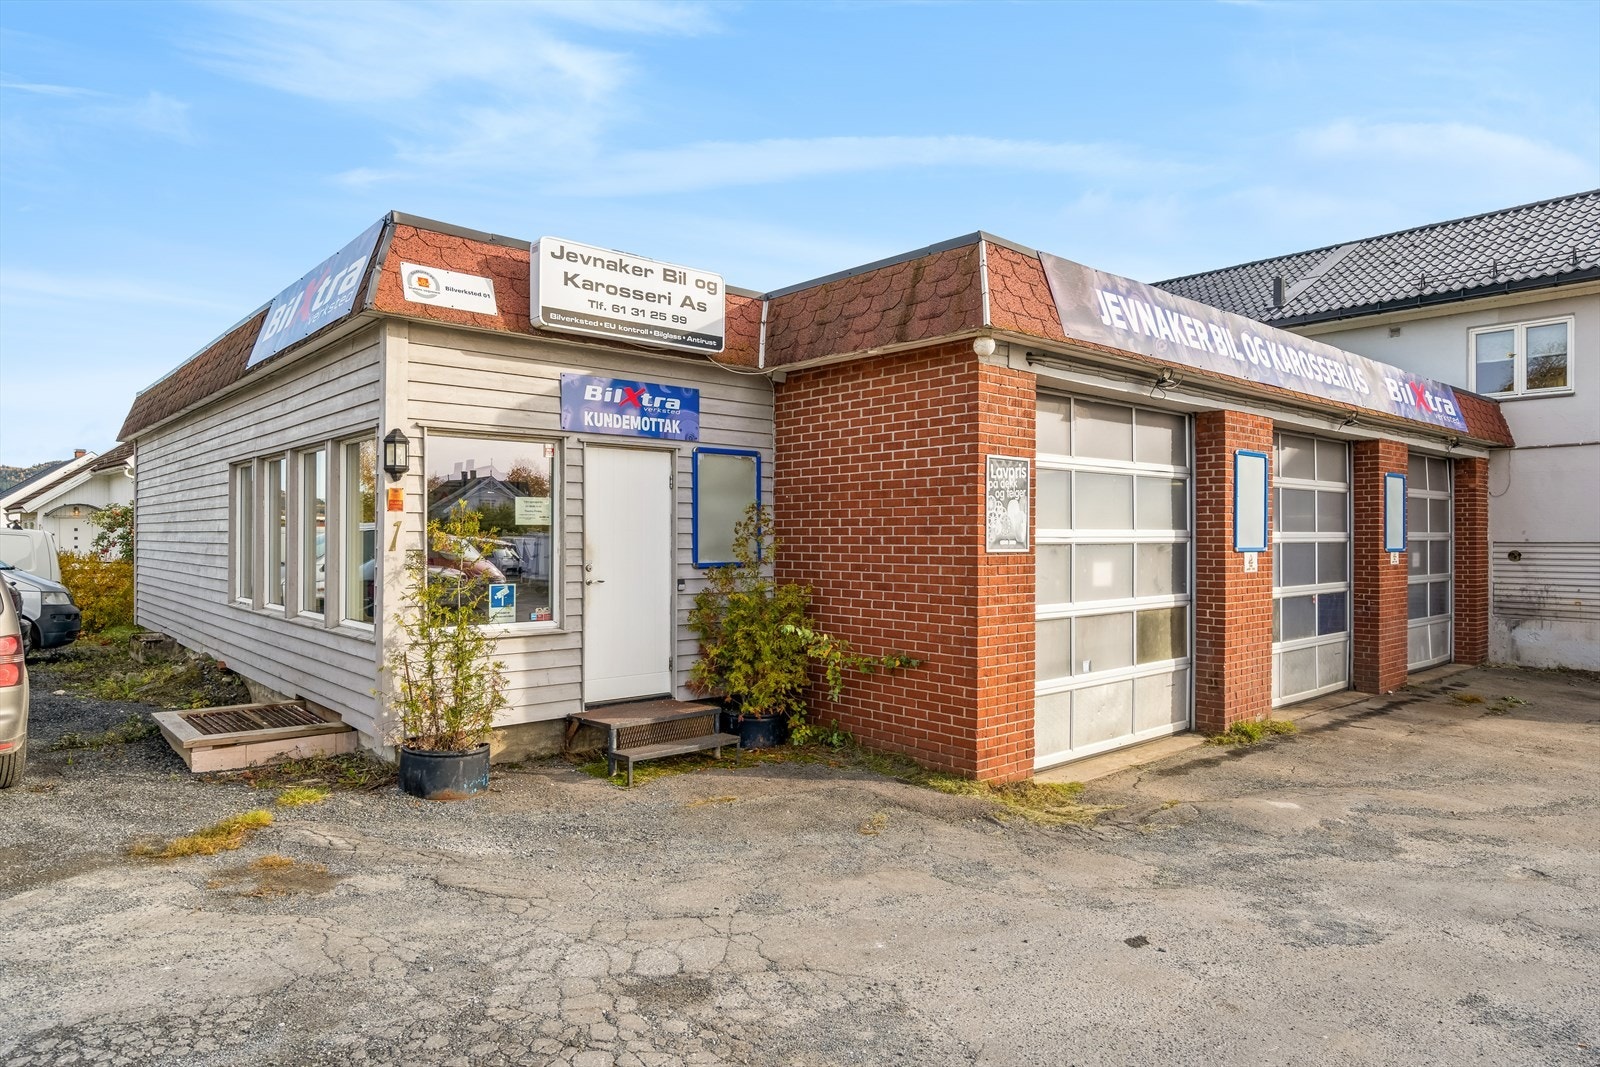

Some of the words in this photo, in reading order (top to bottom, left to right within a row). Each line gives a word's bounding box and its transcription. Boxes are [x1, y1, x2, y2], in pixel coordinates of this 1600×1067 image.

[550, 246, 654, 278] Jevnaker
[663, 268, 687, 286] Bil
[695, 277, 717, 296] og
[563, 271, 672, 306] Karosseri
[680, 296, 707, 313] As
[588, 299, 607, 311] Tlf.
[612, 304, 626, 315] 61
[631, 307, 646, 318] 31
[651, 311, 667, 321] 25
[671, 314, 687, 325] 99
[550, 312, 599, 327] Bilverksted
[604, 322, 616, 330] EU
[618, 324, 648, 335] kontroll
[654, 330, 682, 340] Bilglass
[686, 335, 717, 346] Antirust
[1095, 288, 1215, 354] JEVNAKER
[1208, 322, 1246, 362] BIL
[1240, 332, 1272, 369] OG
[1265, 339, 1351, 390] KAROSSERI
[1347, 365, 1370, 395] AS
[584, 385, 681, 410] BilXtra
[644, 407, 681, 415] verksted
[1384, 377, 1457, 417] BilXtra
[584, 411, 681, 434] KUNDEMOTTAK
[995, 489, 1005, 500] og
